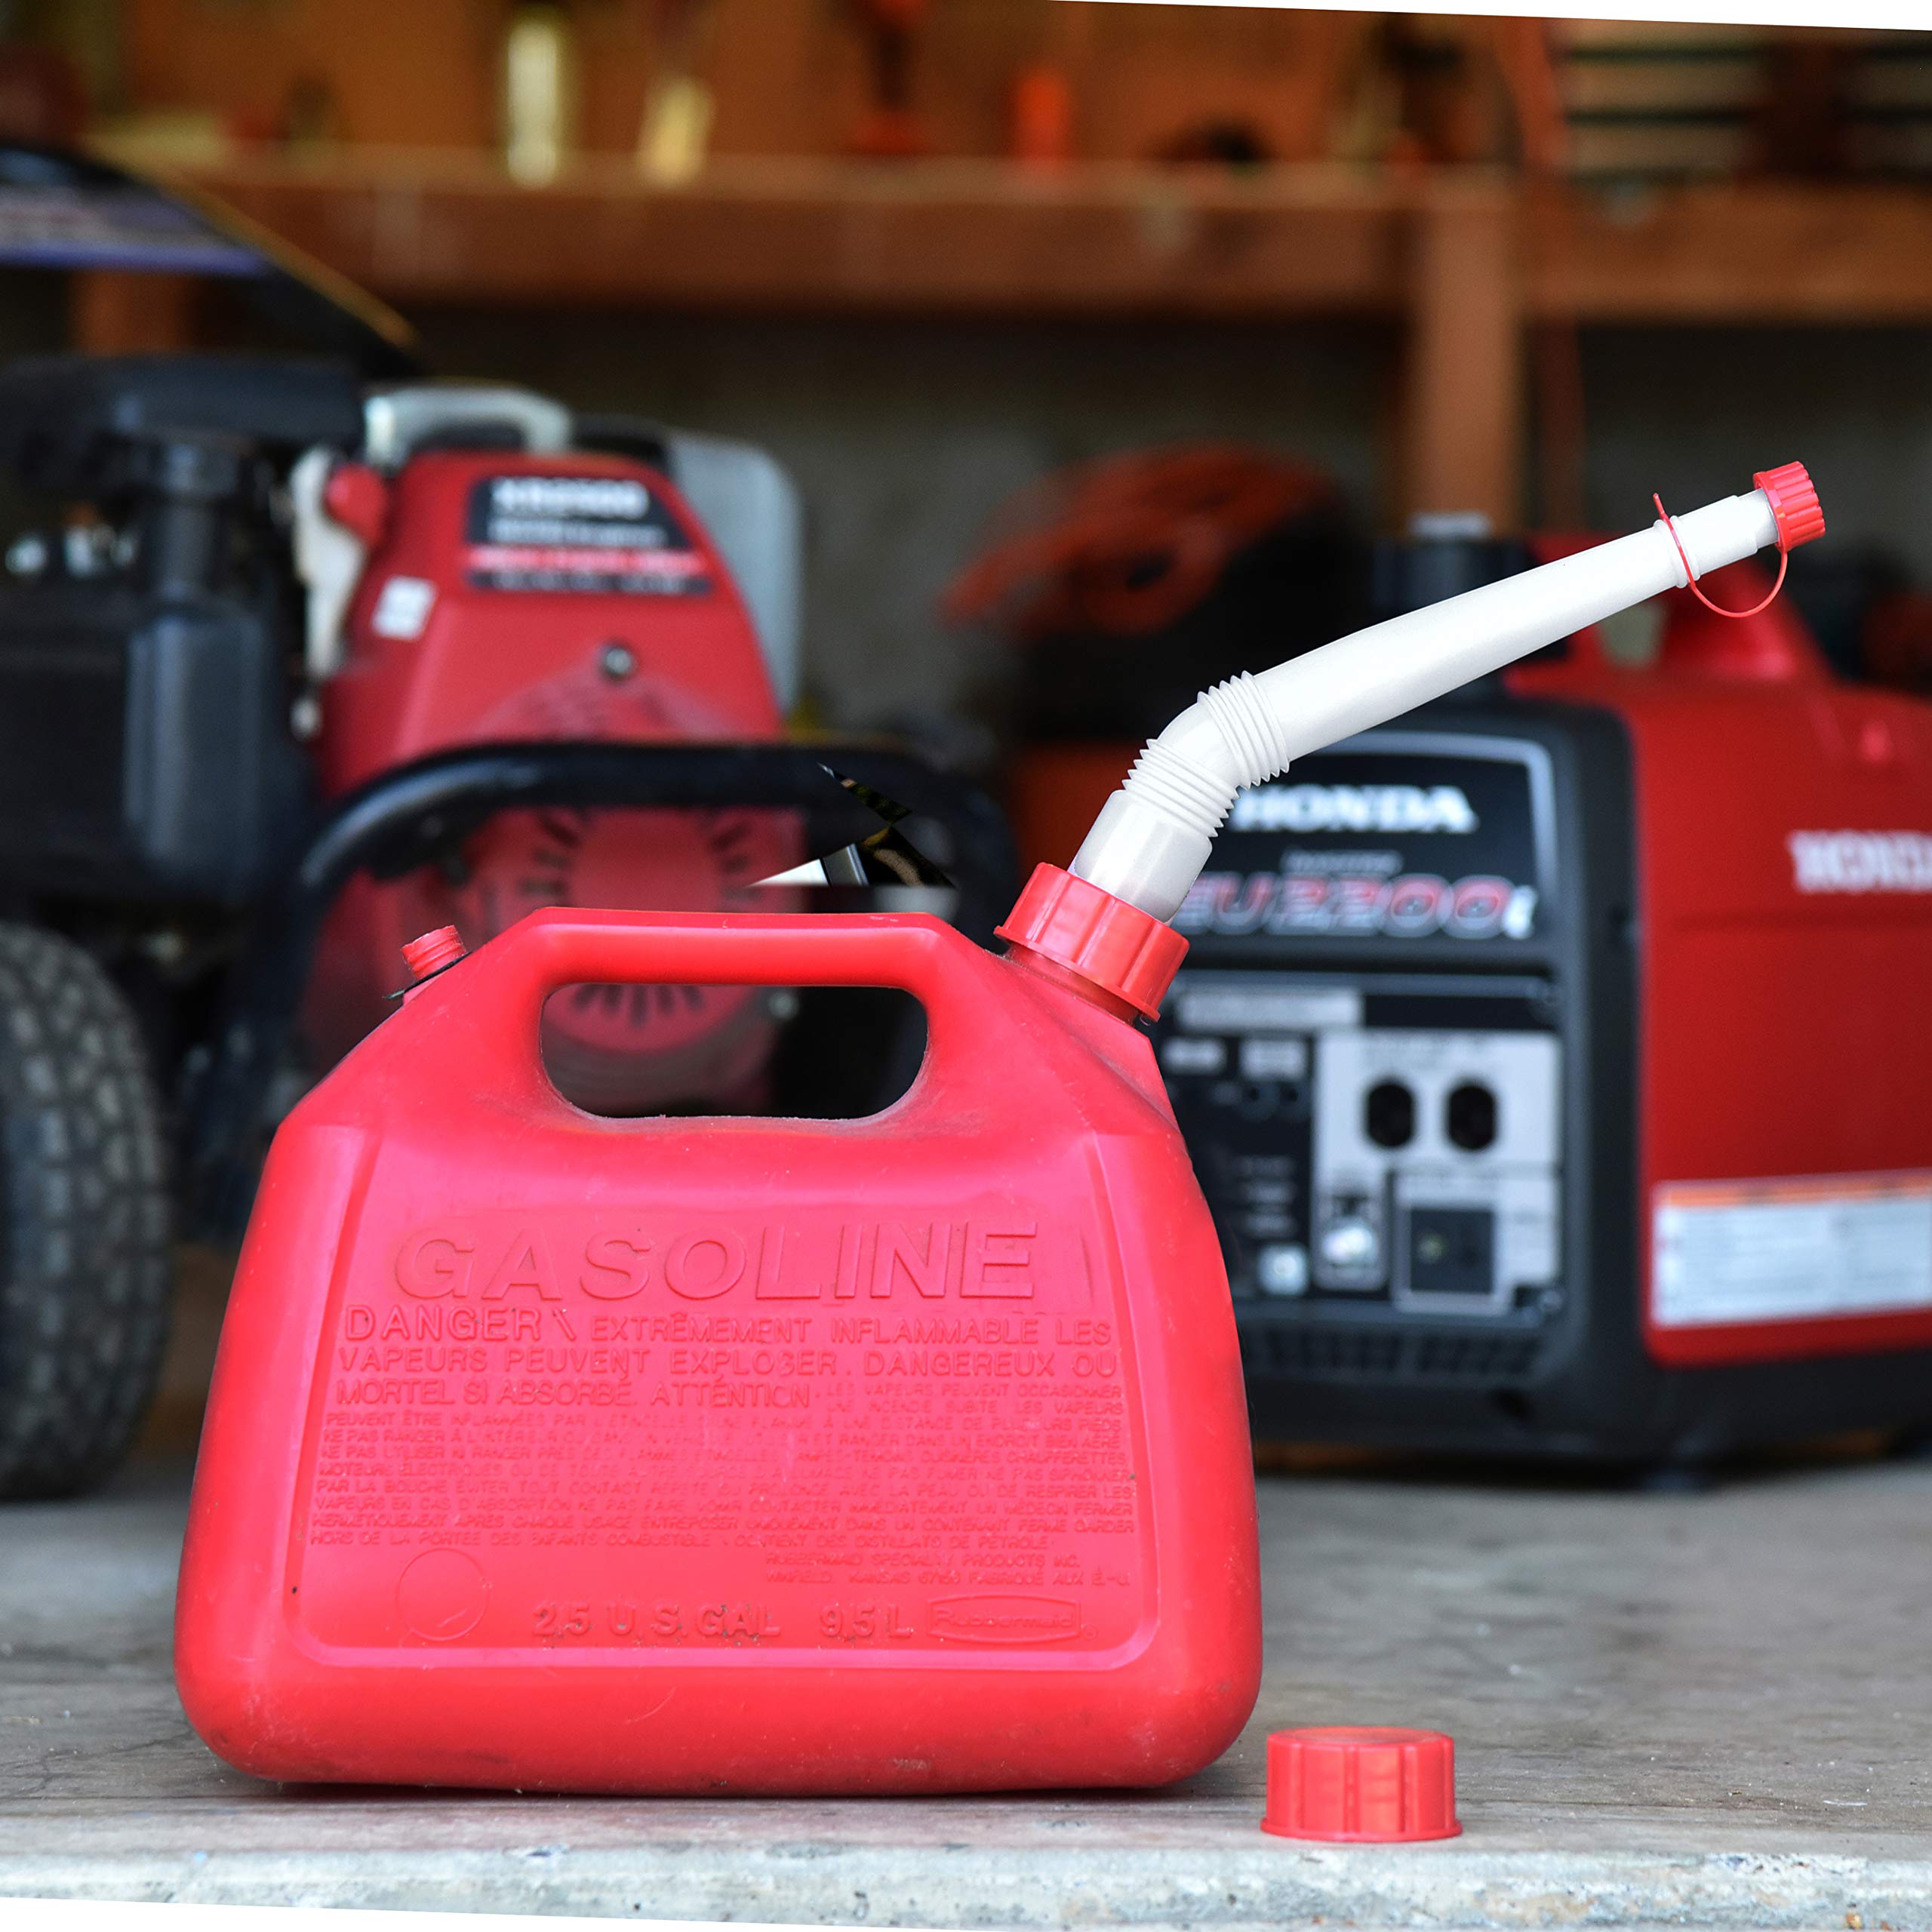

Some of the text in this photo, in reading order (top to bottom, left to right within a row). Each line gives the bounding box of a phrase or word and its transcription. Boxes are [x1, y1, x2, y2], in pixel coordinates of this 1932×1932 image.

[1227, 785, 1478, 832] HONDA
[394, 1221, 1038, 1302] GASOLINE
[346, 1305, 542, 1342] DANGER
[831, 1316, 1038, 1345] INFLAMMABLE
[1054, 1318, 1110, 1346] LES
[338, 1346, 488, 1373] VAPEURS
[503, 1348, 651, 1374] PEUVENT
[863, 1350, 1055, 1378] DANGEREUX
[1071, 1352, 1117, 1379] OU
[337, 1378, 457, 1406] MORTEL
[463, 1379, 490, 1407] SI
[1014, 1400, 1043, 1414] LES
[1054, 1401, 1124, 1415] VAPEURS
[326, 1412, 396, 1426] PEUVENT
[554, 1414, 586, 1427] PAR
[963, 1417, 983, 1431] DE
[346, 1429, 380, 1443] PAS
[383, 1430, 445, 1444] RANGER
[905, 1433, 946, 1447] DANS
[976, 1434, 1040, 1447] ENDROIT
[346, 1445, 378, 1460] PAS
[472, 1447, 532, 1461] RANGER
[1012, 1467, 1043, 1481] PAS
[316, 1479, 349, 1493] PAR
[355, 1479, 376, 1494] LA
[518, 1481, 560, 1494] TOUT
[568, 1481, 641, 1495] CONTACT
[917, 1483, 961, 1498] PEAU
[967, 1484, 989, 1498] OU
[996, 1484, 1018, 1499] DE
[1025, 1484, 1097, 1499] RESPIRER
[1103, 1484, 1132, 1500] LES
[315, 1496, 386, 1510] VAPEURS
[391, 1497, 411, 1511] EN
[419, 1497, 451, 1511] CAS
[975, 1501, 997, 1515] UN
[1072, 1502, 1133, 1516] FERMER
[894, 1517, 915, 1531] UN
[310, 1531, 354, 1546] HORS
[358, 1531, 382, 1546] DE
[388, 1532, 412, 1546] LA
[765, 1552, 863, 1565] RUBBERMAID
[961, 1552, 1046, 1567] PRODUCTS
